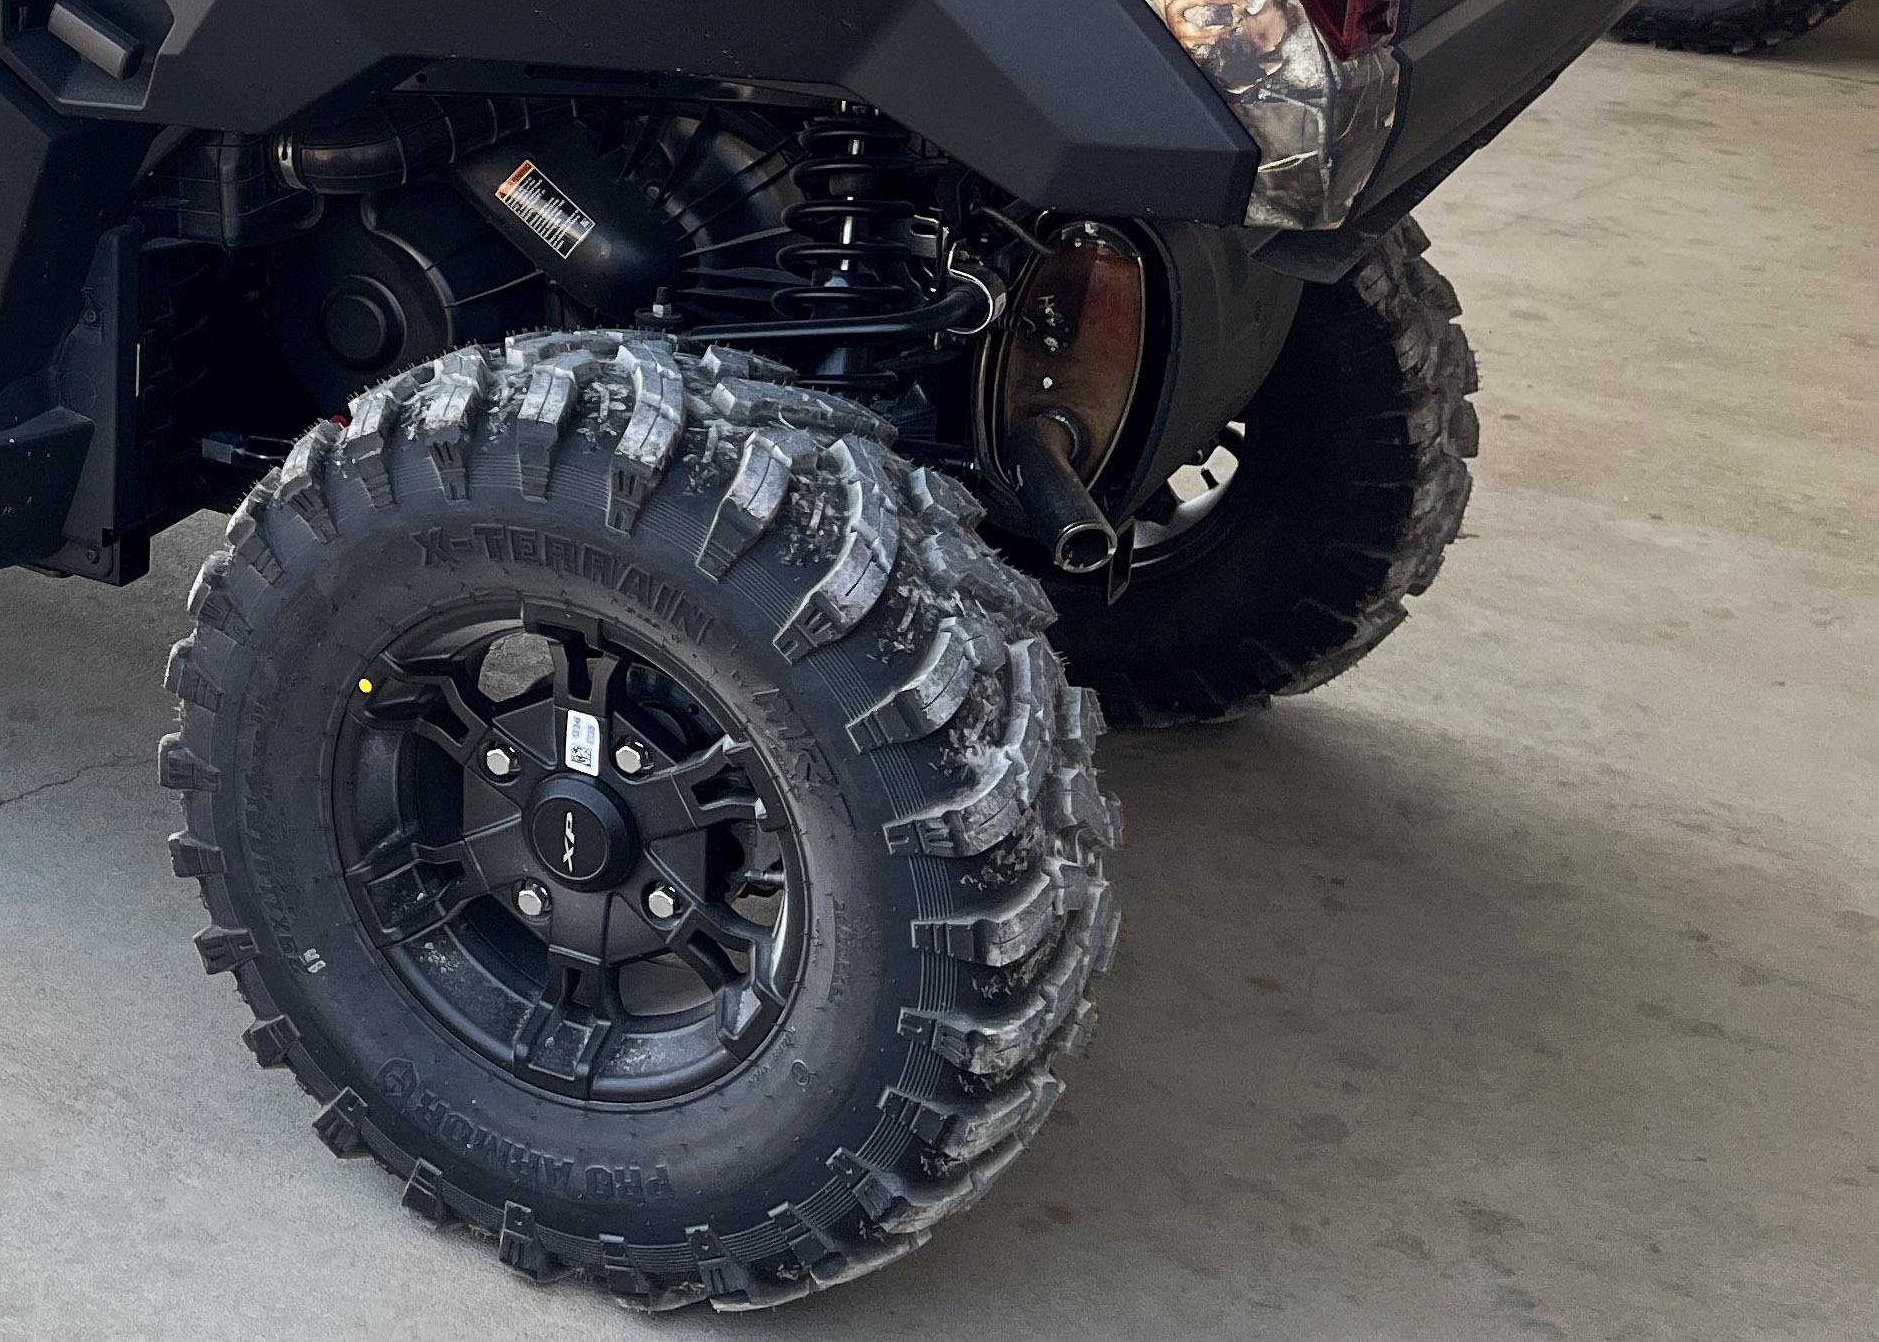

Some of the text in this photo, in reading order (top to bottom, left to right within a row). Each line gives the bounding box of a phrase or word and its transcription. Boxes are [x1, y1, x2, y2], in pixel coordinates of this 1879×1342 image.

[409, 522, 716, 646] X-TERRAIN
[563, 811, 575, 873] XP
[415, 1087, 673, 1204] PRO ARMOR
